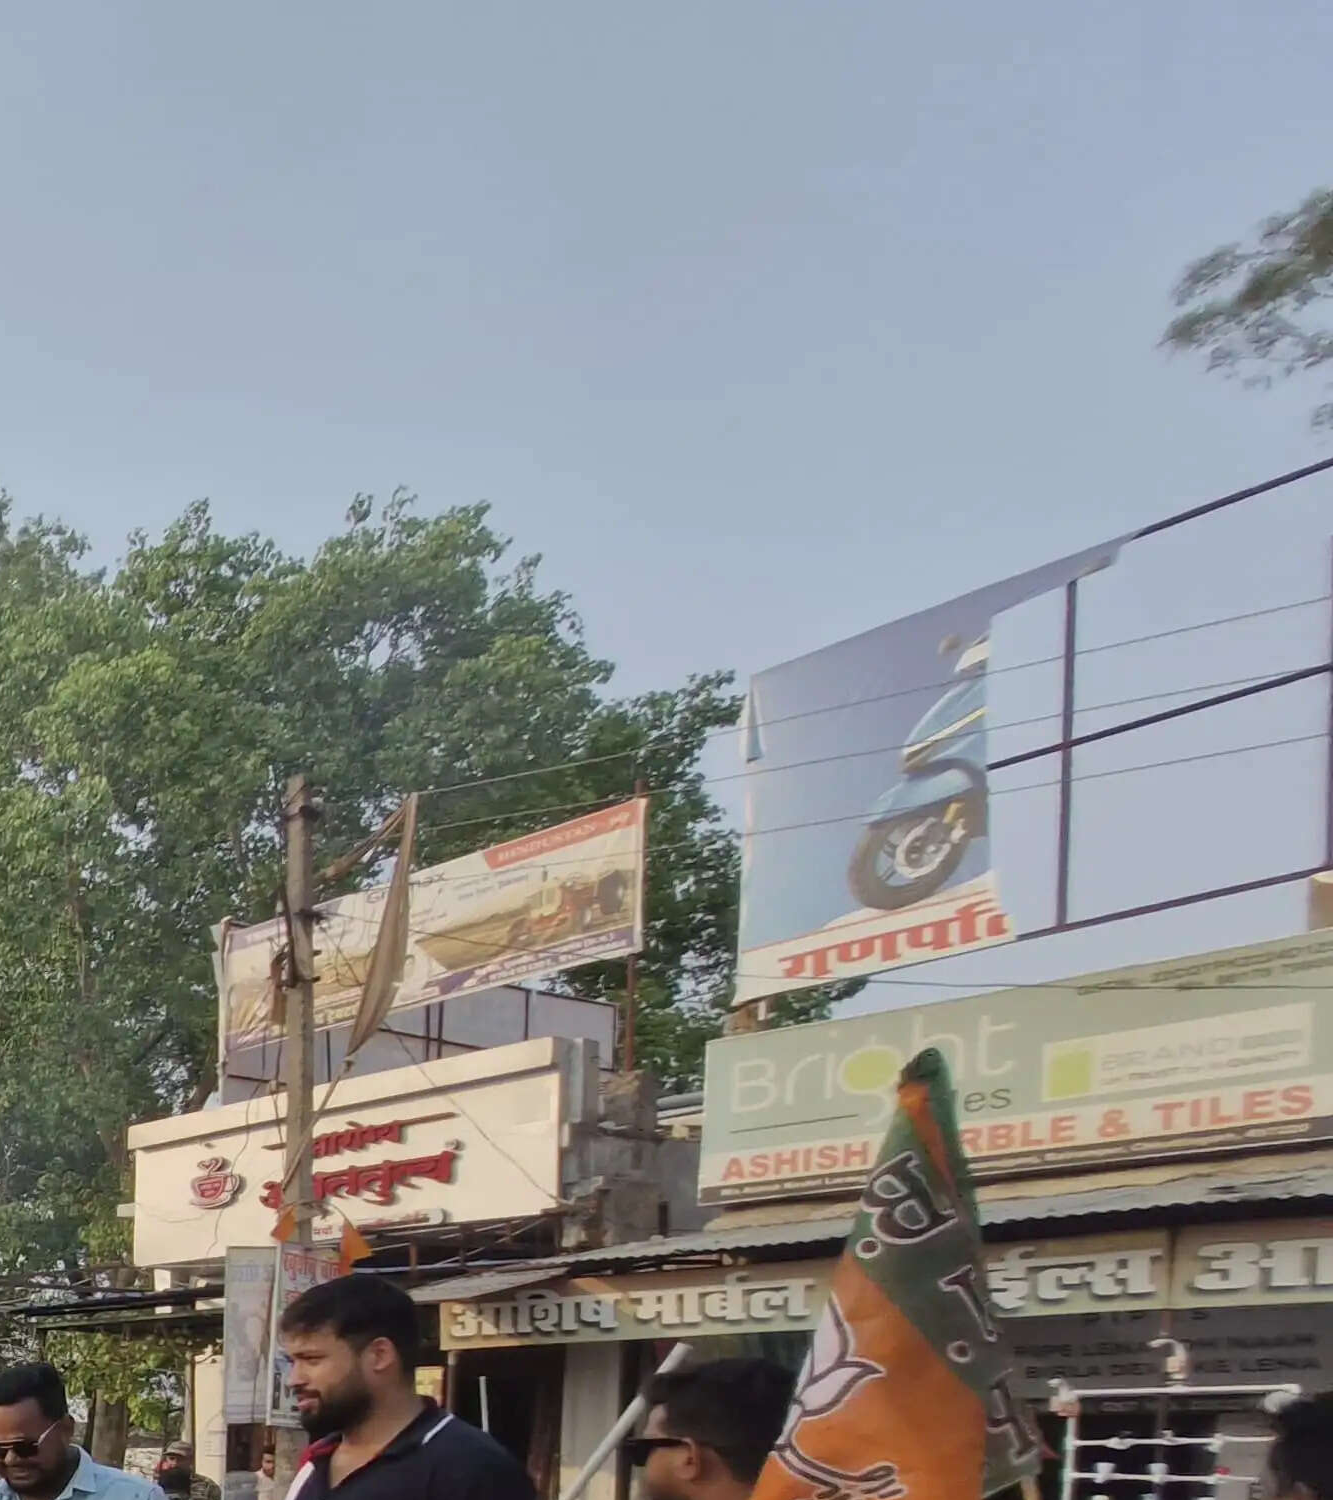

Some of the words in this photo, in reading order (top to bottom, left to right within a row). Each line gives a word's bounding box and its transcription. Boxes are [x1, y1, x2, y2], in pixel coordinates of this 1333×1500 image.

[730, 1014, 1014, 1127] Bright
[722, 1140, 869, 1183] ASHISH
[962, 1114, 1076, 1152] RBLE
[1097, 1108, 1131, 1138] &
[1153, 1085, 1314, 1131] TILES
[450, 1288, 618, 1339] आशिष
[633, 1273, 813, 1326] मार्बल
[987, 1246, 1162, 1310] ईल्स
